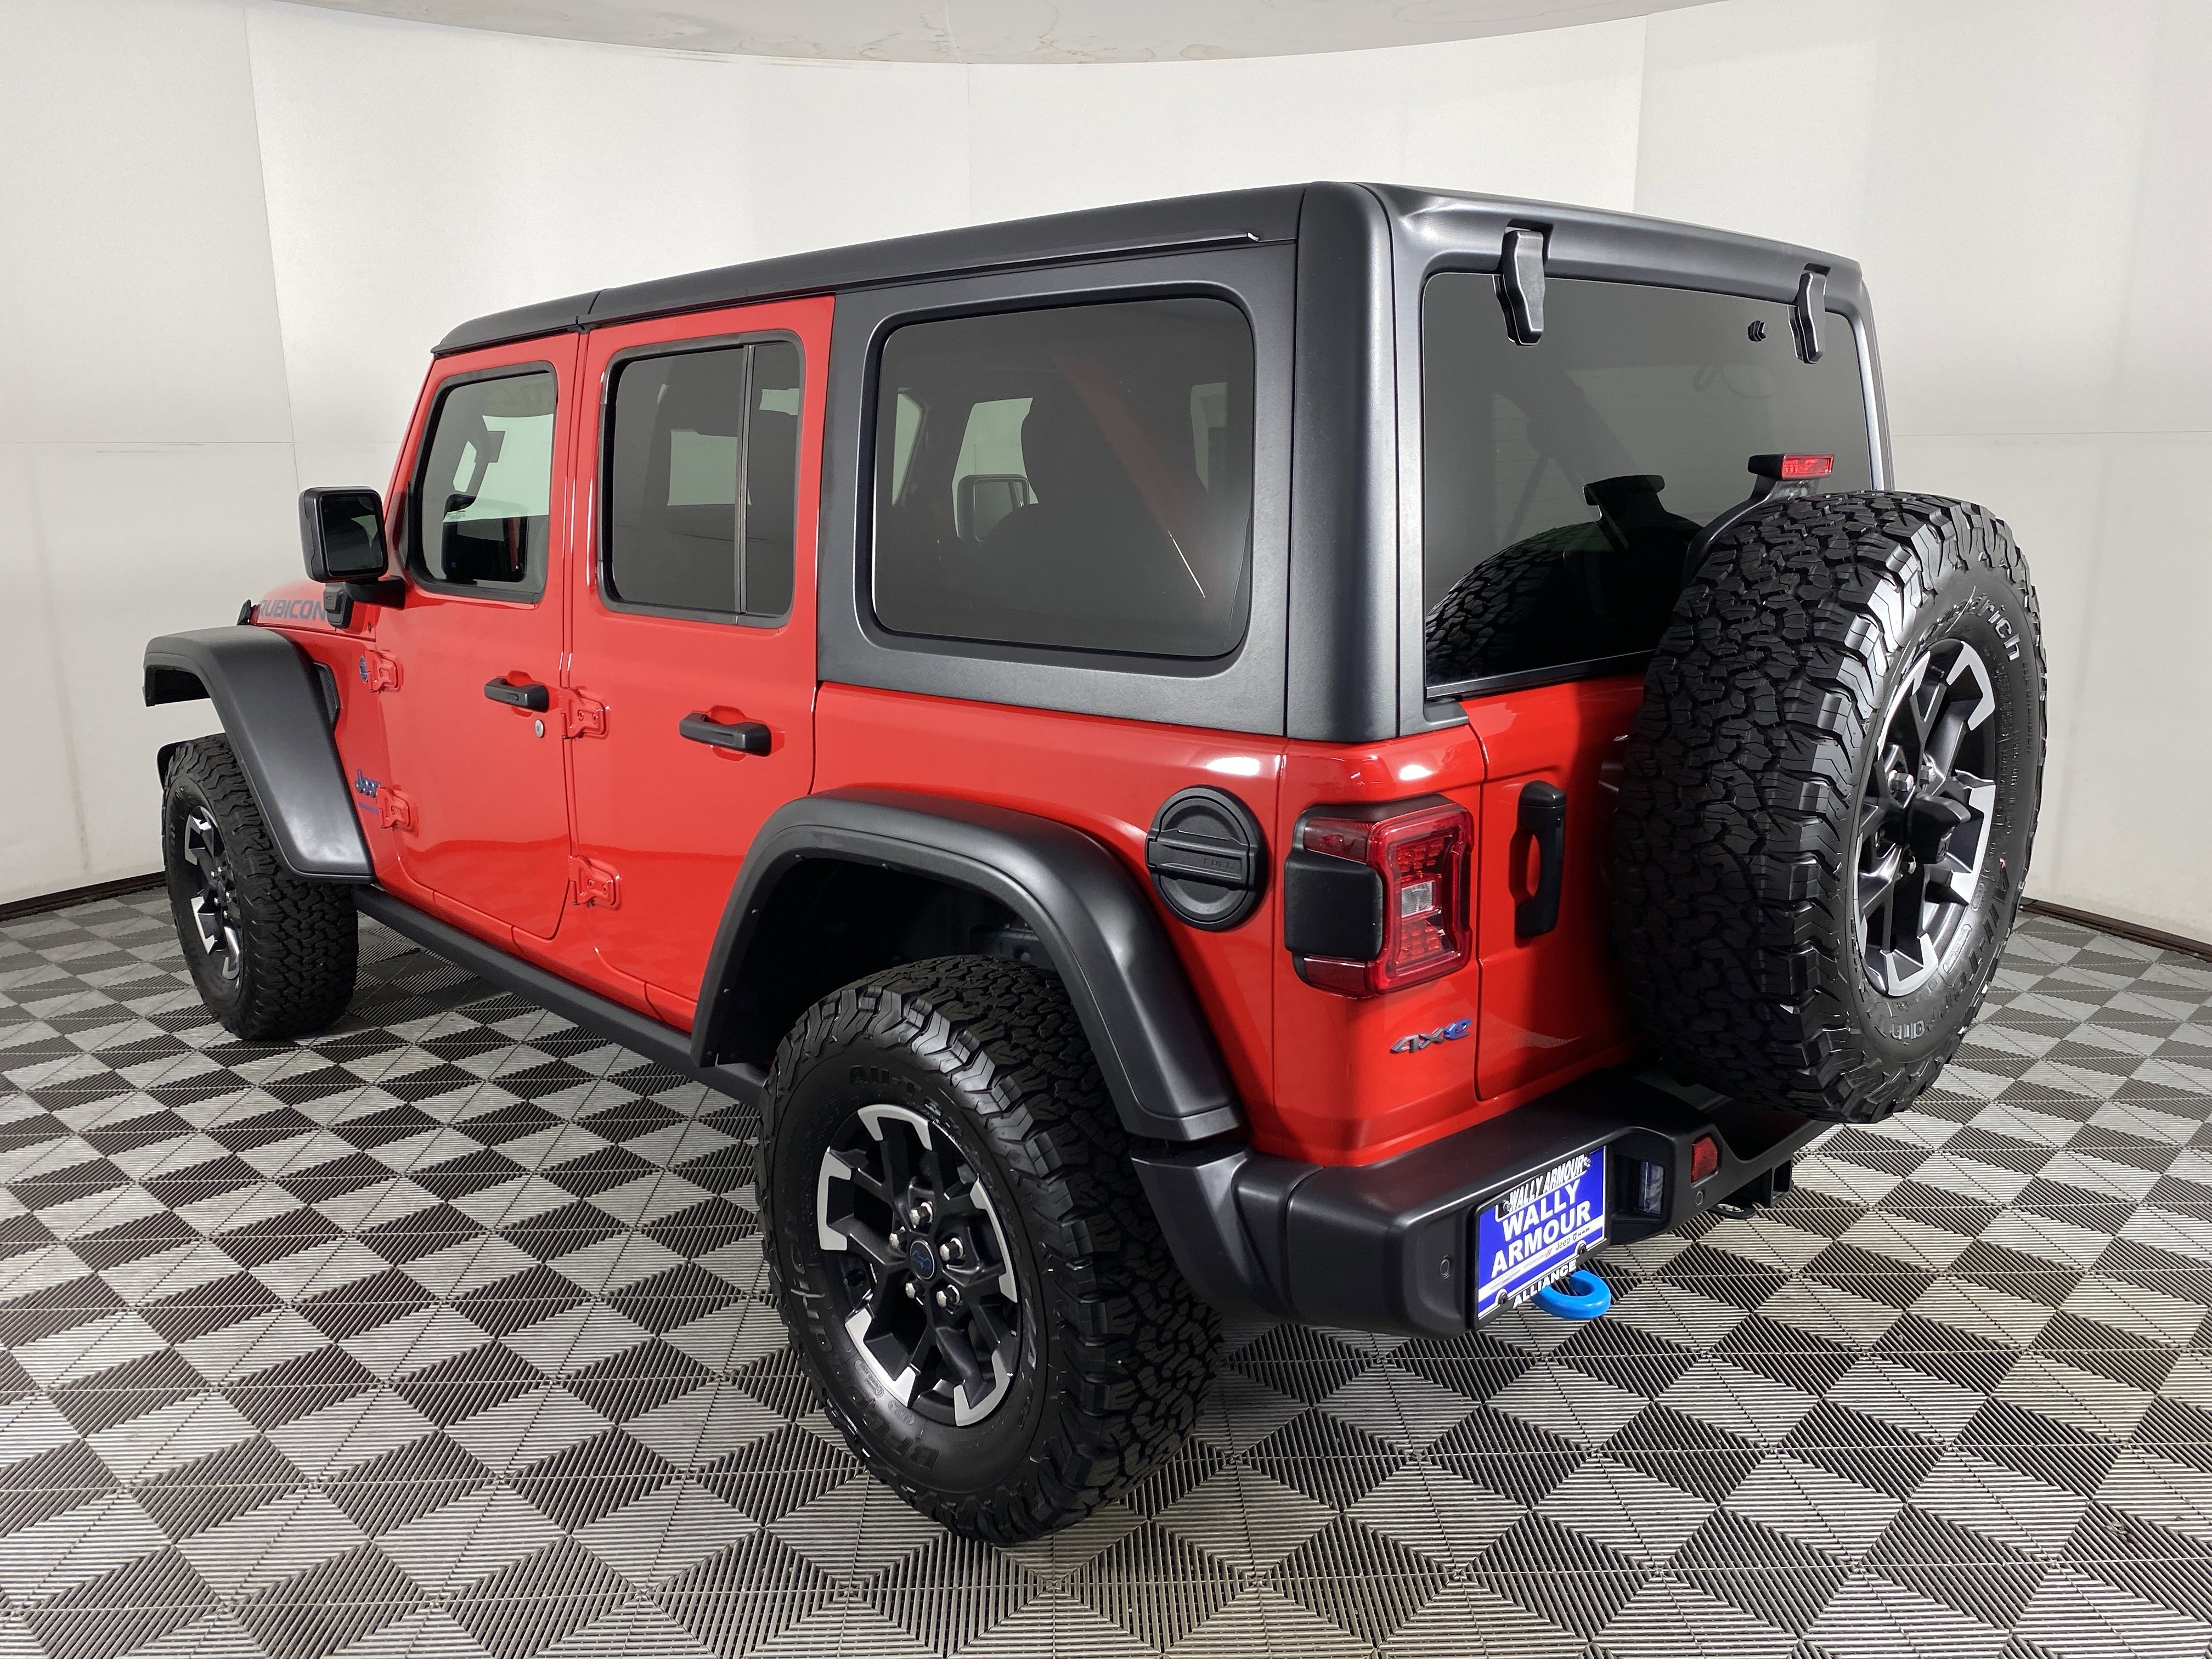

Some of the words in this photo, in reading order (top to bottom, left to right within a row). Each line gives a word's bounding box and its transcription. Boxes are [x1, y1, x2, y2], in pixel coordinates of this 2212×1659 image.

[259, 599, 328, 622] RUBICON
[1204, 858, 1234, 870] FUEL
[1508, 1175, 1544, 1214] WALLY
[1542, 1153, 1585, 1194] ARMOUR
[1502, 1178, 1581, 1243] WALLY
[1490, 1200, 1591, 1279] ARMOUR
[1555, 1237, 1570, 1251] Jeep
[1578, 1227, 1590, 1237] RAM
[1512, 1259, 1577, 1309] ALLIANCE
